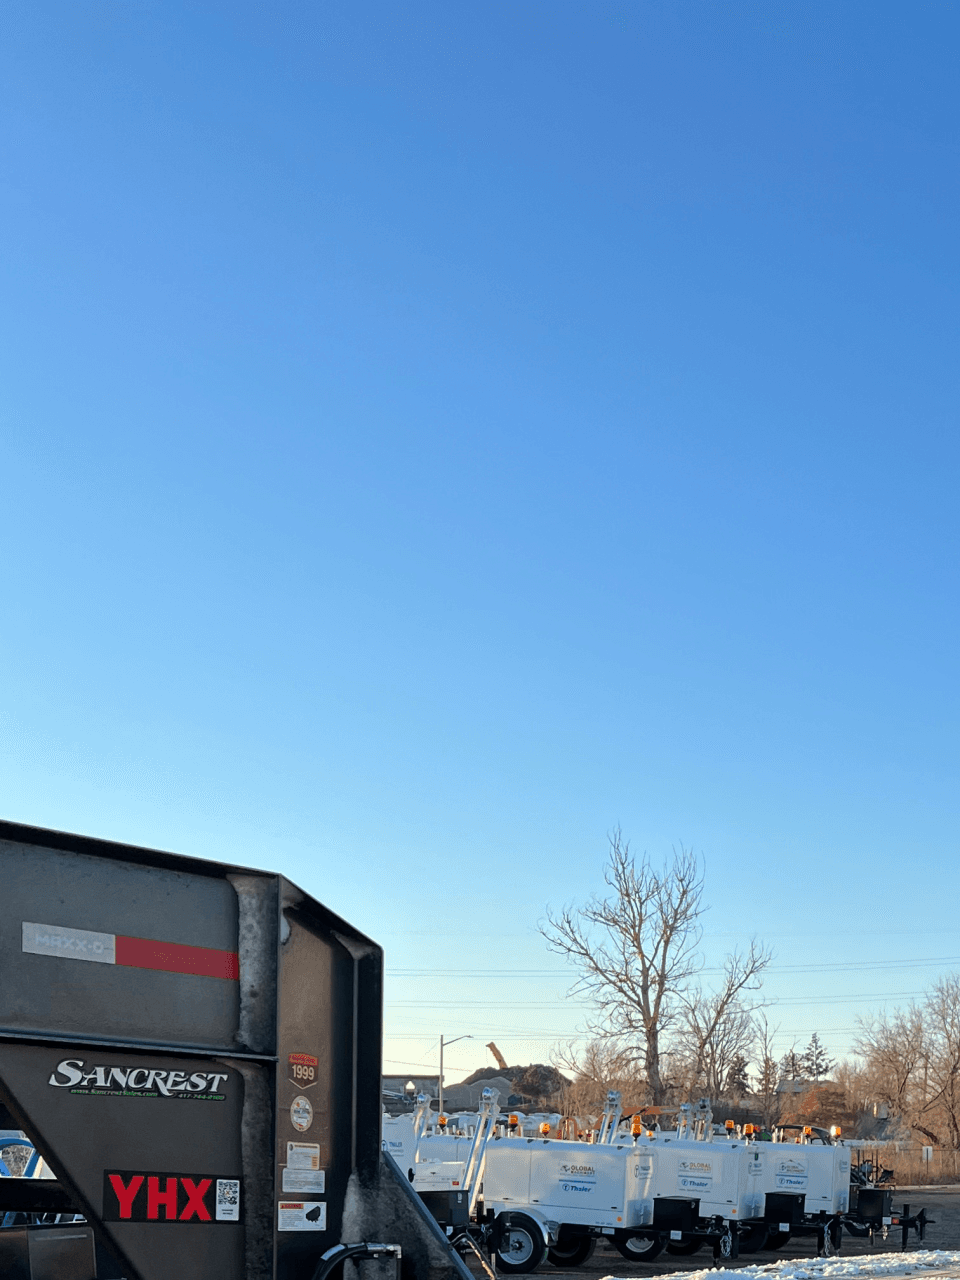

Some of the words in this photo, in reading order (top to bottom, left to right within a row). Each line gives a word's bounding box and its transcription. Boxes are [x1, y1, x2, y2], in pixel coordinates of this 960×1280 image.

[49, 1059, 228, 1096] SANCREST
[291, 1064, 315, 1080] 1999
[108, 1174, 213, 1221] YHX
